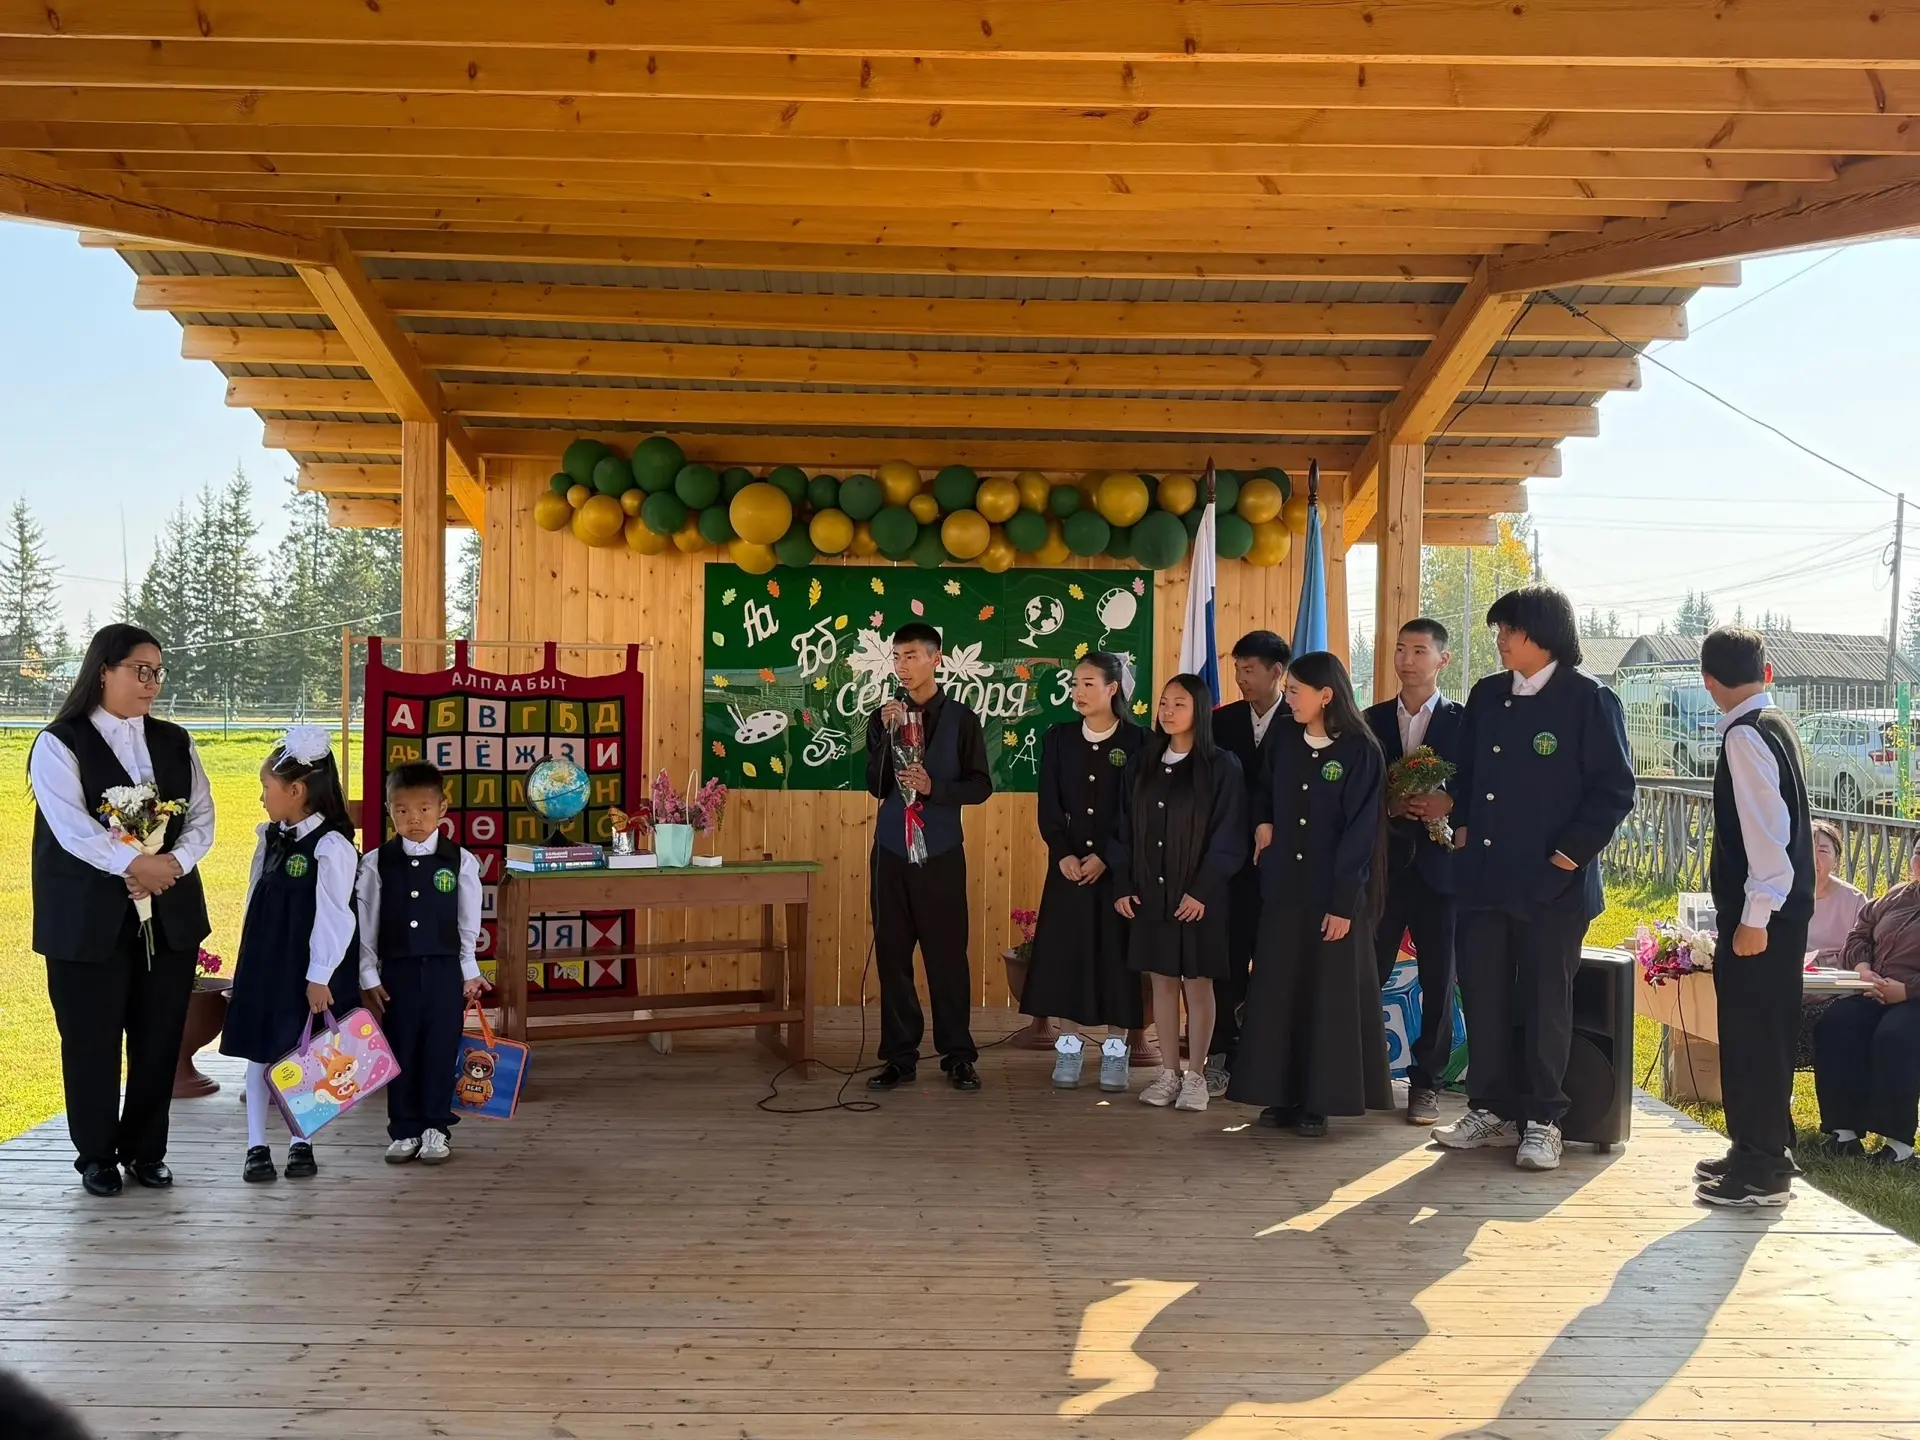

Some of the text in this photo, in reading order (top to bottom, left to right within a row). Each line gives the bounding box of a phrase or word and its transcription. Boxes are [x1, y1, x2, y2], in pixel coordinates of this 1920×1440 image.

[743, 598, 779, 648] Аа
[791, 615, 837, 679] Бб
[451, 672, 567, 692] АЛПААБЫТ
[391, 703, 416, 730] А
[437, 701, 456, 728] Б
[479, 704, 497, 729] В
[522, 706, 537, 731] Г
[594, 703, 619, 733] Д
[437, 742, 452, 767] Е
[476, 740, 491, 767] Ё
[515, 744, 536, 764] Ж
[597, 742, 618, 767] И
[473, 778, 495, 804] Л
[471, 816, 496, 840] Ө
[516, 816, 537, 840] П
[554, 924, 573, 948] Я
